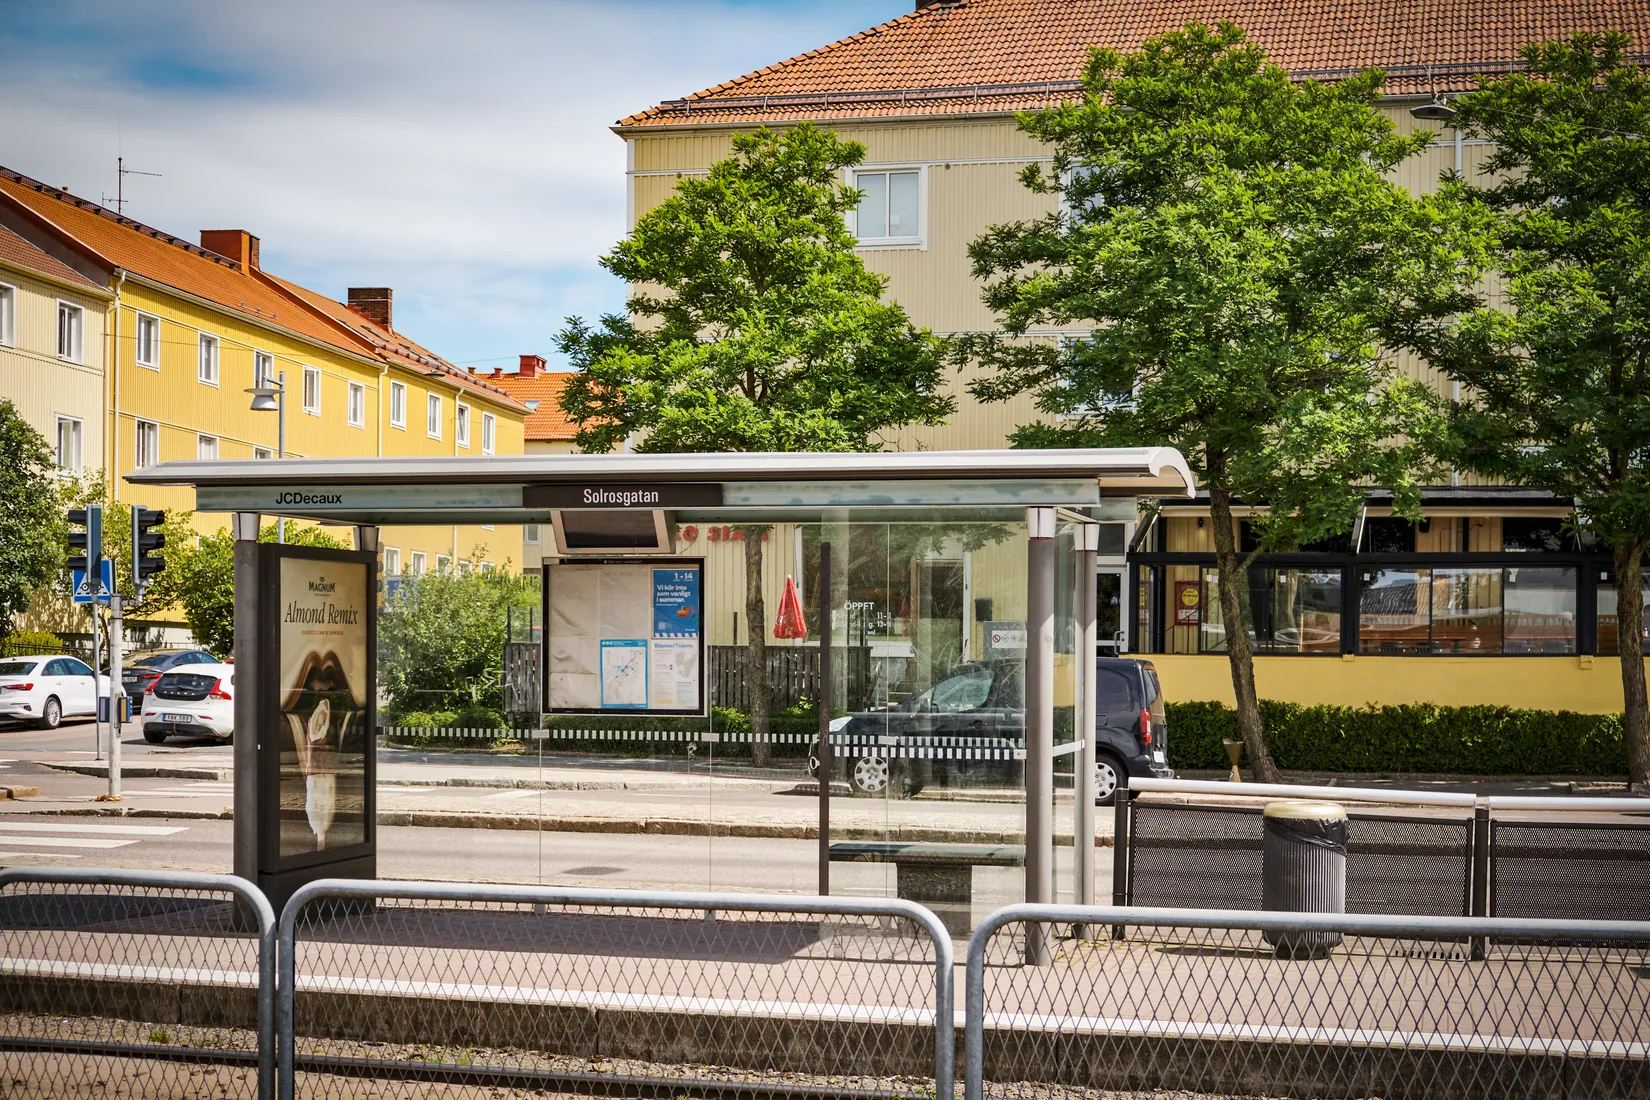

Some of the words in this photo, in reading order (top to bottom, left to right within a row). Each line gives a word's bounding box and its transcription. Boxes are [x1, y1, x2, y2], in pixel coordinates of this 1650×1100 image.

[276, 492, 342, 504] JCDecaux
[583, 488, 659, 506] Solrosgatan
[284, 601, 326, 624] Almond
[328, 604, 358, 625] Remix
